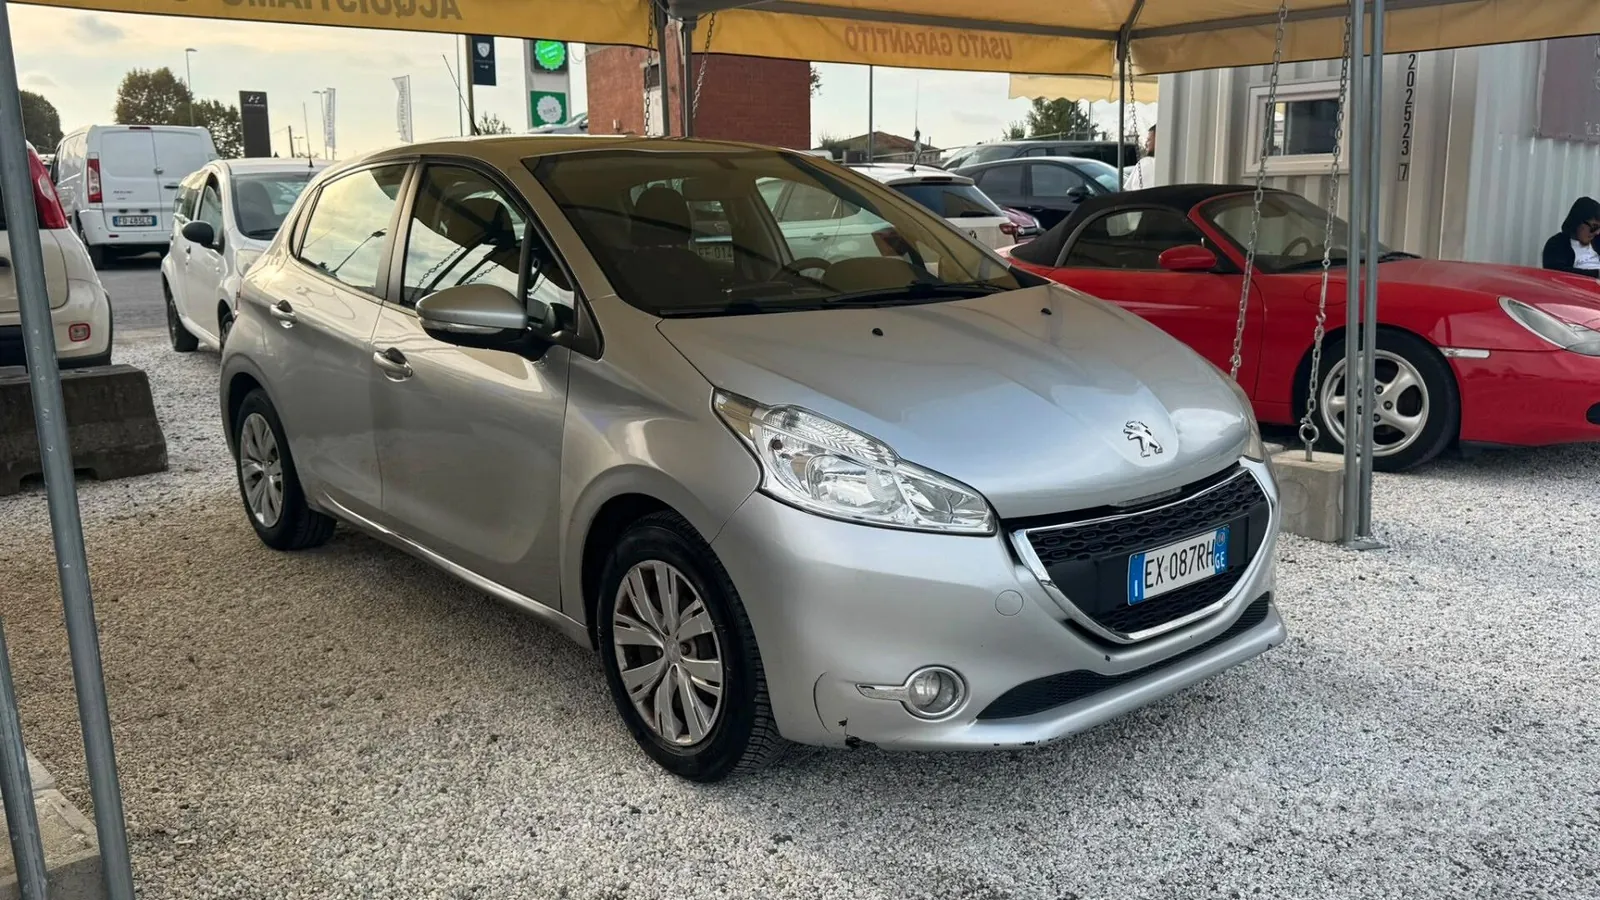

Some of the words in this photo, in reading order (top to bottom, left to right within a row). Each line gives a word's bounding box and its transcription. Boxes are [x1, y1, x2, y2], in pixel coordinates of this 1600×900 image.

[1401, 53, 1416, 156] 202523
[1145, 555, 1165, 589] EX
[1169, 539, 1215, 580] 087RH
[1215, 551, 1225, 569] GE
